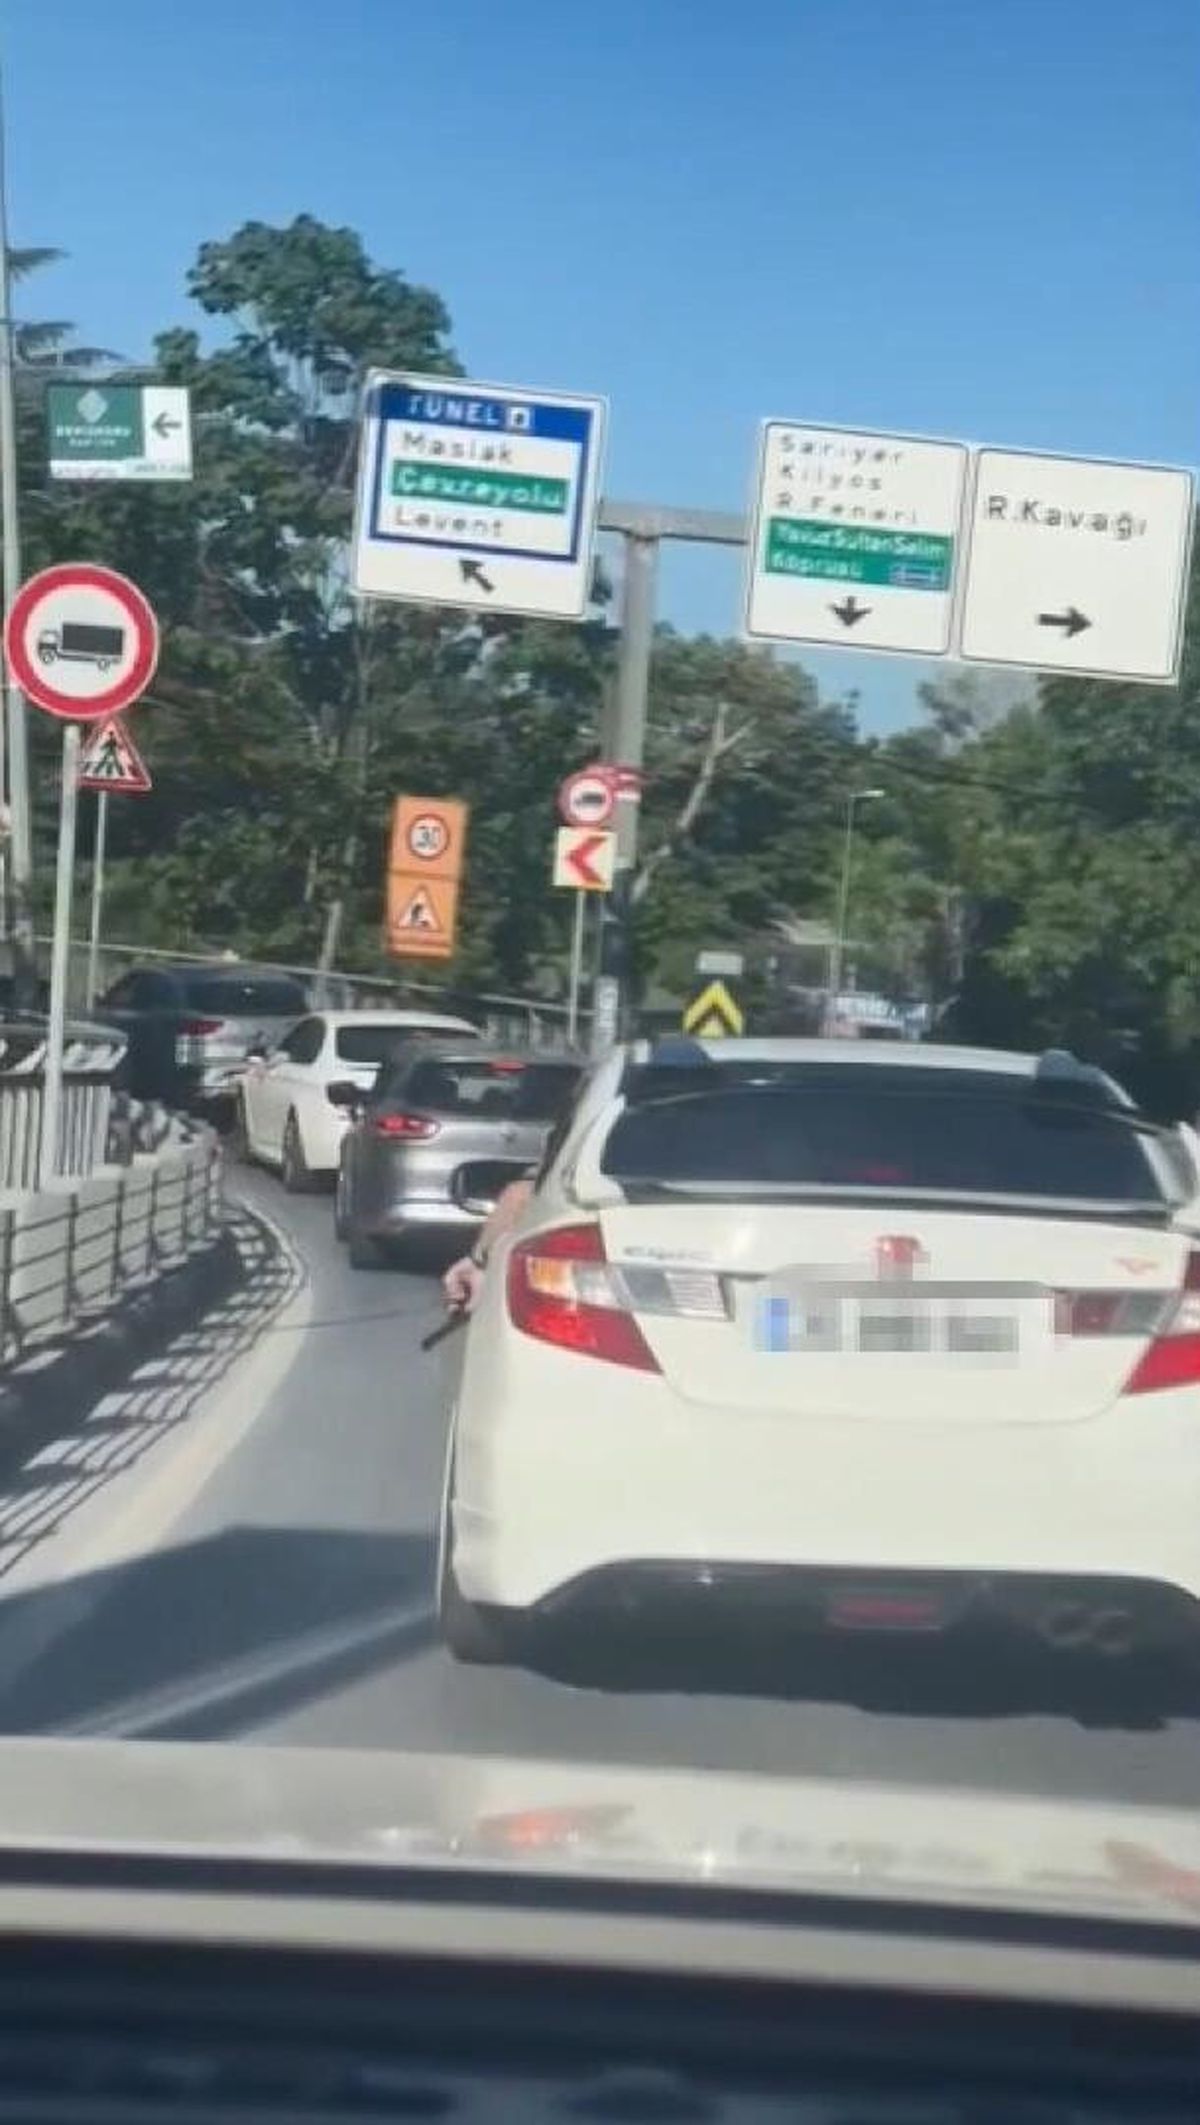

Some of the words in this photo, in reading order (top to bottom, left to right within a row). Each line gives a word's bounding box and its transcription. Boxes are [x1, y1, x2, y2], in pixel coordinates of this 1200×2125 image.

[402, 431, 512, 463] Maslak
[395, 505, 504, 538] Levent
[417, 826, 441, 848] 30
